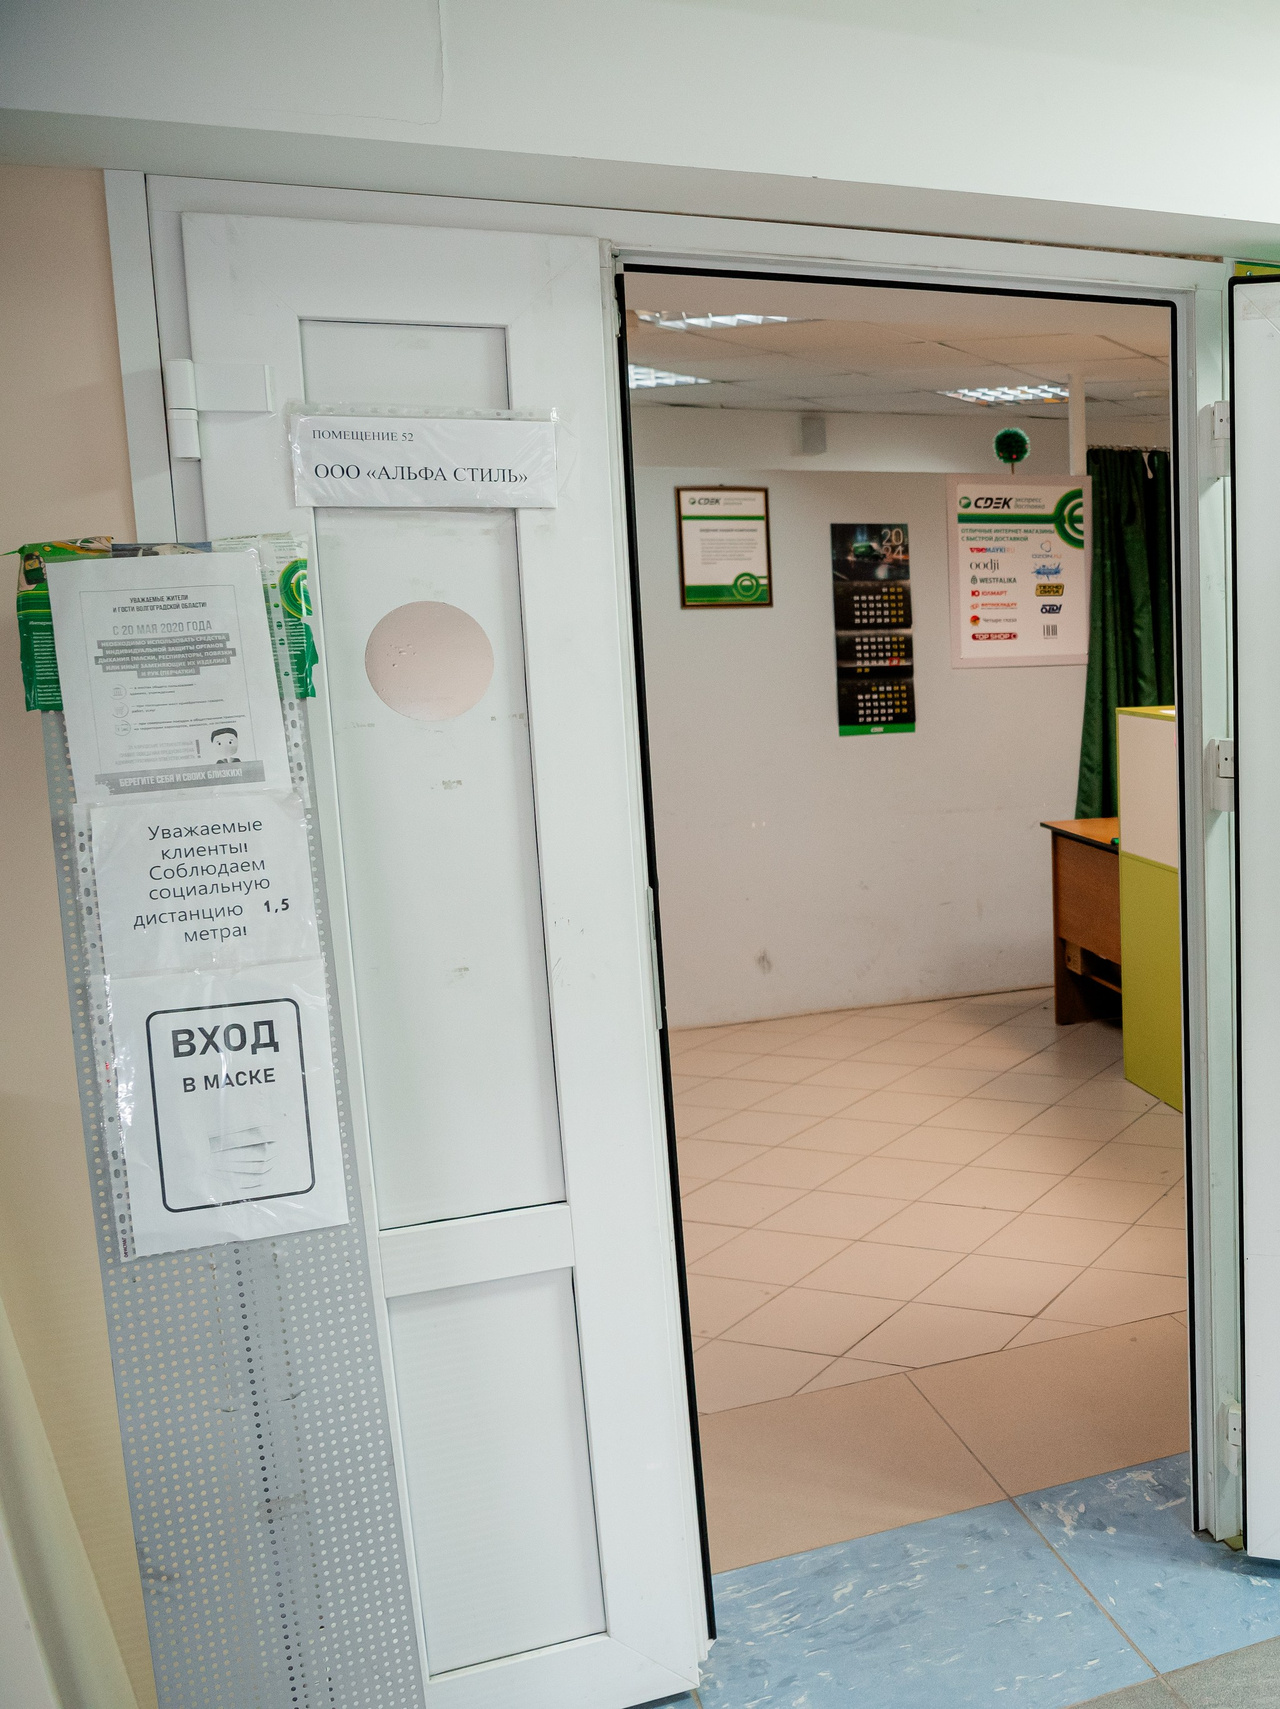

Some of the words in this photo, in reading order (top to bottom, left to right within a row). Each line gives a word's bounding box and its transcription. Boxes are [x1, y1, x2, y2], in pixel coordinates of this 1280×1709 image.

[312, 428, 398, 443] ПОМЕЩЕНИЕ
[401, 430, 415, 443] 52
[314, 463, 361, 482] ООО
[366, 464, 448, 484] «АЛЬФА
[453, 465, 528, 485] СТИЛЬ»
[974, 497, 1013, 509] CDEK
[881, 528, 904, 546] 20
[970, 558, 999, 573] oodji
[118, 605, 135, 613] ГОСТИ
[136, 603, 181, 612] ВОЛГОГРАДСКОЙ
[130, 596, 165, 604] УВАЖАЕМЫЕ
[166, 594, 188, 602] ЖИТЕЛИ
[113, 626, 119, 636] С
[122, 625, 134, 635] 20
[137, 624, 158, 635] МАЯ
[160, 622, 184, 634] 2020
[187, 620, 212, 633] ГОДА
[119, 776, 155, 787] БЕРЕГИТЕ
[157, 775, 174, 784] СЕБЯ
[176, 774, 181, 782] И
[182, 772, 206, 781] СВОИХ
[207, 768, 243, 779] БЛИЗКИХ!
[147, 818, 263, 842] Уважаемые
[161, 841, 249, 861] клиенты!
[149, 858, 266, 882] Соблюдаем
[149, 876, 270, 902] социальную
[133, 902, 244, 930] дистанцию
[263, 898, 290, 914] 1,5
[183, 923, 248, 945] метра!
[171, 1020, 280, 1059] ВХОД
[182, 1077, 197, 1093] В
[203, 1067, 277, 1092] МАСКЕ
